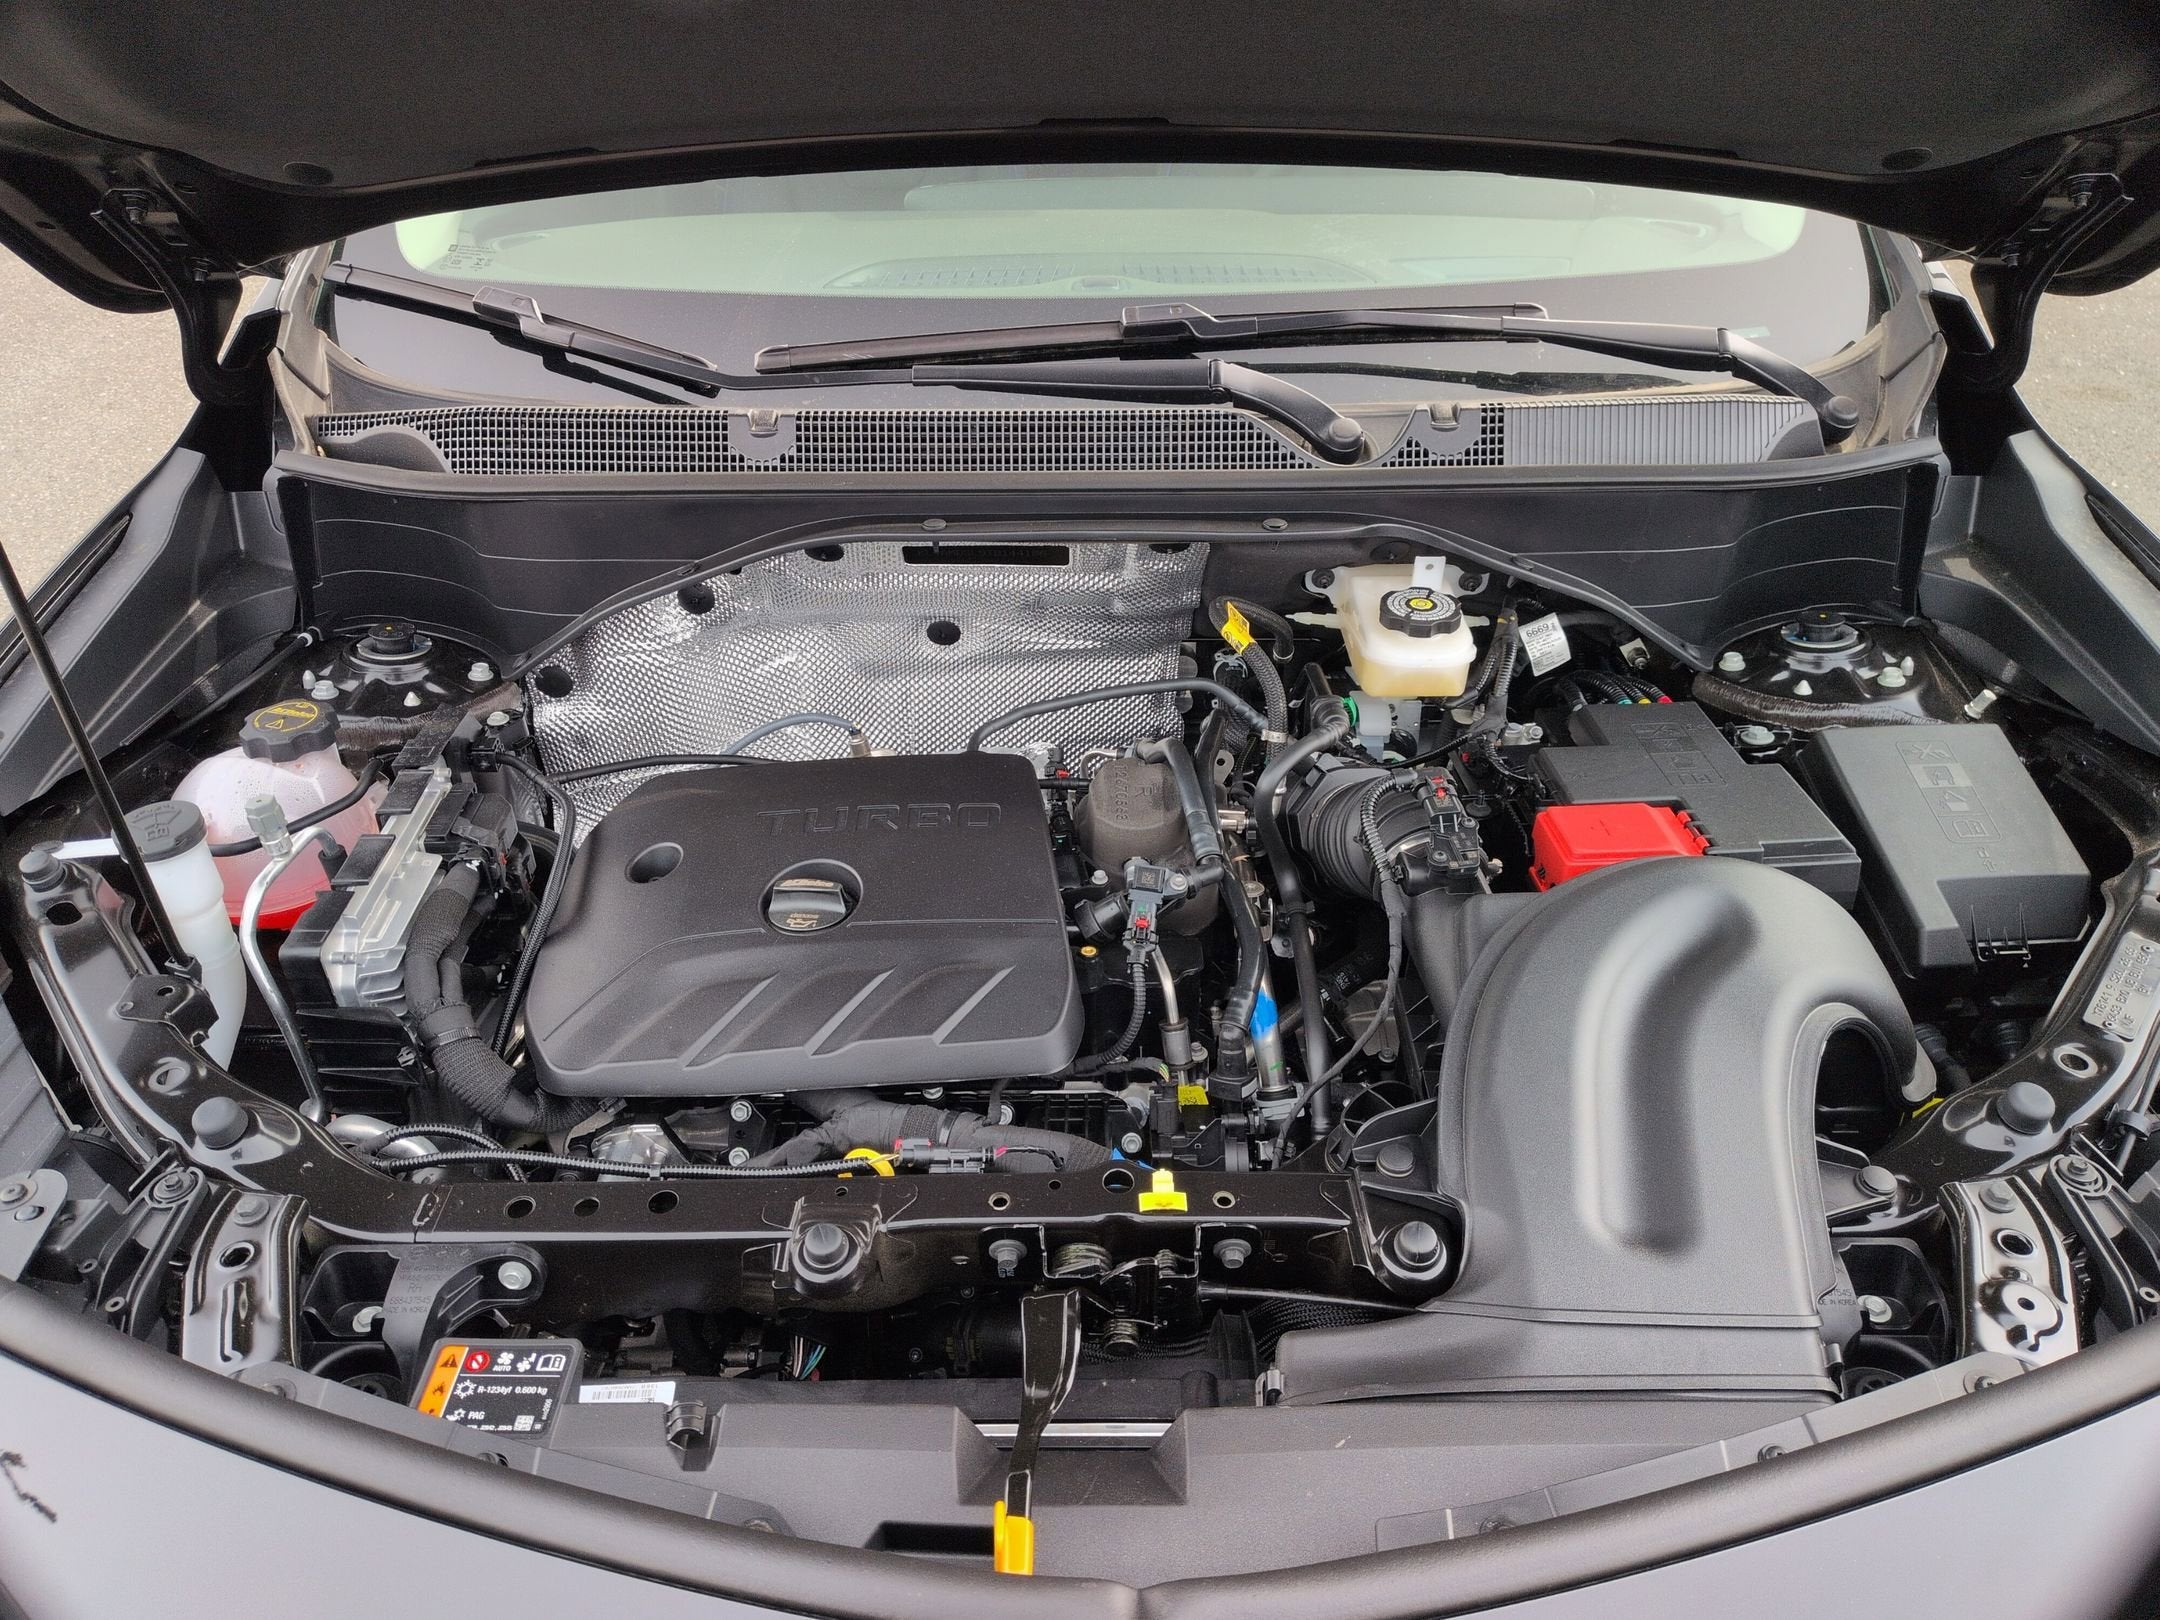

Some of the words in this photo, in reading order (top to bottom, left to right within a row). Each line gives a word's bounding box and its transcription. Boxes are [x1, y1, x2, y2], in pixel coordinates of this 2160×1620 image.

[1526, 623, 1549, 637] 6669
[757, 802, 1001, 836] TURBO
[408, 1282, 422, 1293] RH
[478, 1386, 512, 1395] R-1234yf
[515, 1386, 537, 1394] 0.600
[537, 1386, 548, 1395] kg
[468, 1411, 485, 1420] PAG
